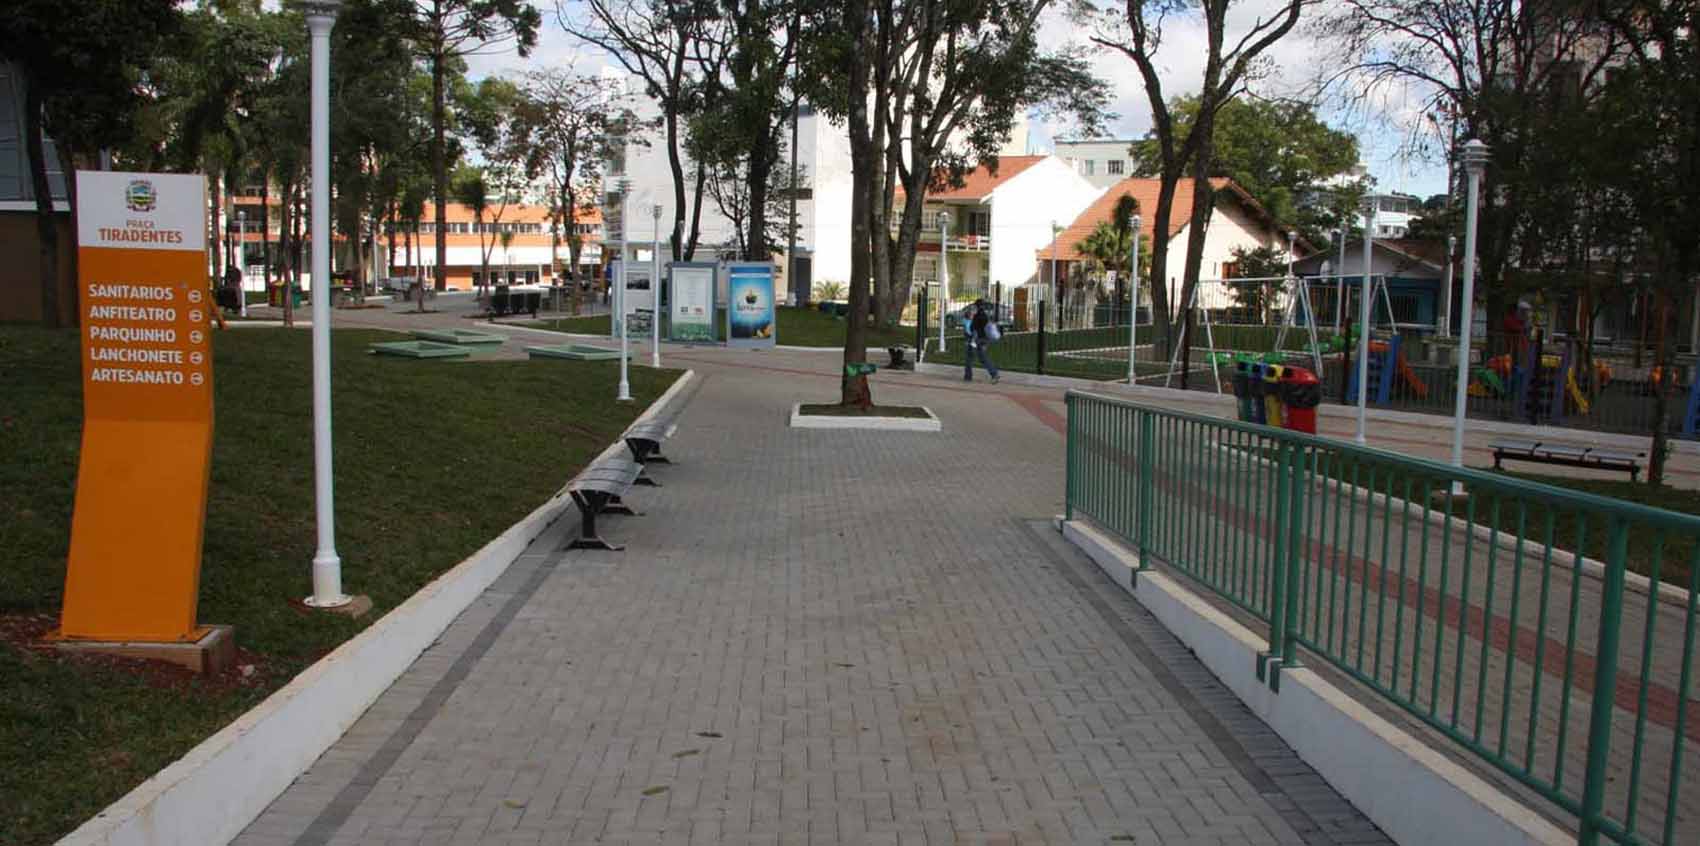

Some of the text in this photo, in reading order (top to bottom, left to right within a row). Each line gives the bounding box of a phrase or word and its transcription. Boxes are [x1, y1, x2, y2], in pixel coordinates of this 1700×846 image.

[126, 219, 154, 229] PRAÇA
[98, 228, 183, 244] TIRADENTES
[88, 283, 173, 301] SANITARIOS
[90, 306, 176, 322] ANFITEATRO
[90, 326, 176, 343] PARQUINHO
[90, 348, 183, 364] LANCHONETE
[91, 368, 183, 384] ARTESANATO
